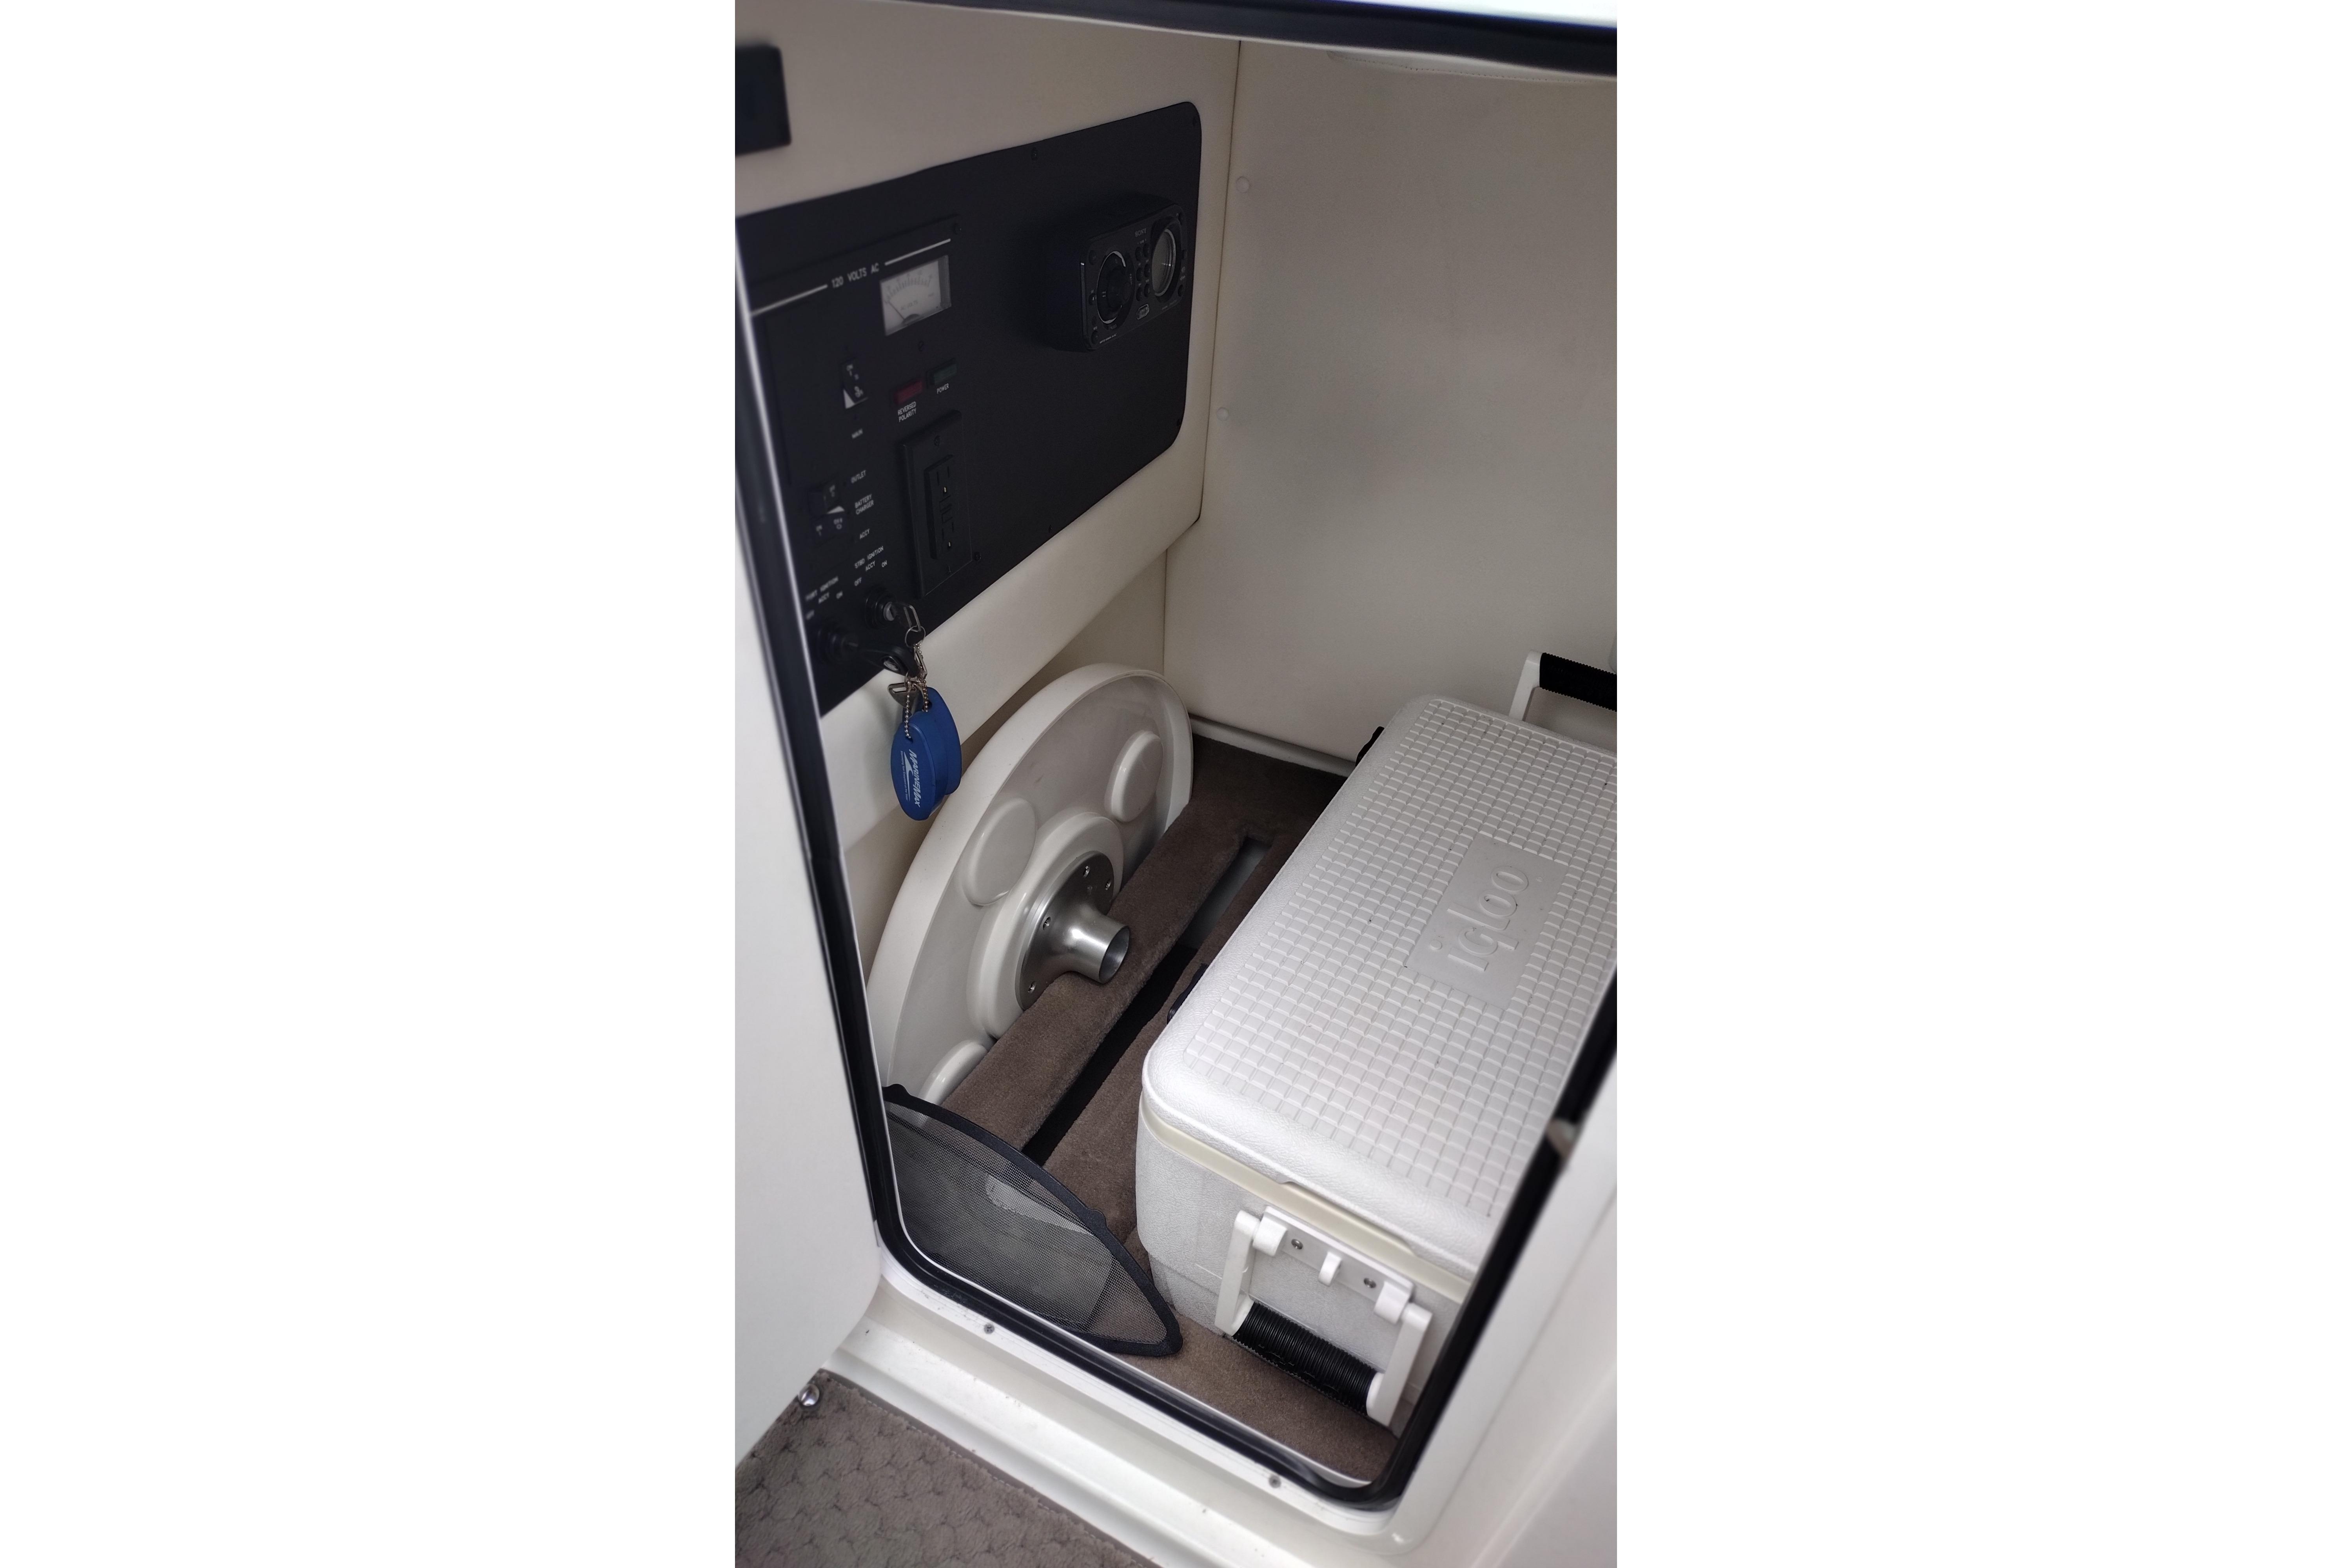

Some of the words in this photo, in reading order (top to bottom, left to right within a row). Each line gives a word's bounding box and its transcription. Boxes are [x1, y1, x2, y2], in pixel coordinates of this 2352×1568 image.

[1135, 228, 1147, 237] SONY
[831, 277, 844, 288] 120
[847, 268, 867, 281] VOLTS
[871, 263, 879, 273] AC
[936, 383, 949, 394] POWER
[897, 401, 916, 416] REVERSED
[898, 408, 917, 422] POLARITY
[851, 470, 867, 484] OUTLET
[855, 494, 872, 508] BATTERY
[856, 500, 874, 515] CHARGER
[859, 528, 870, 540] ACCY
[854, 558, 865, 569] STBD
[867, 545, 884, 560] IGNITION
[865, 561, 876, 572] ACCY
[854, 577, 862, 586] OFF
[1429, 866, 1528, 972] igloo
